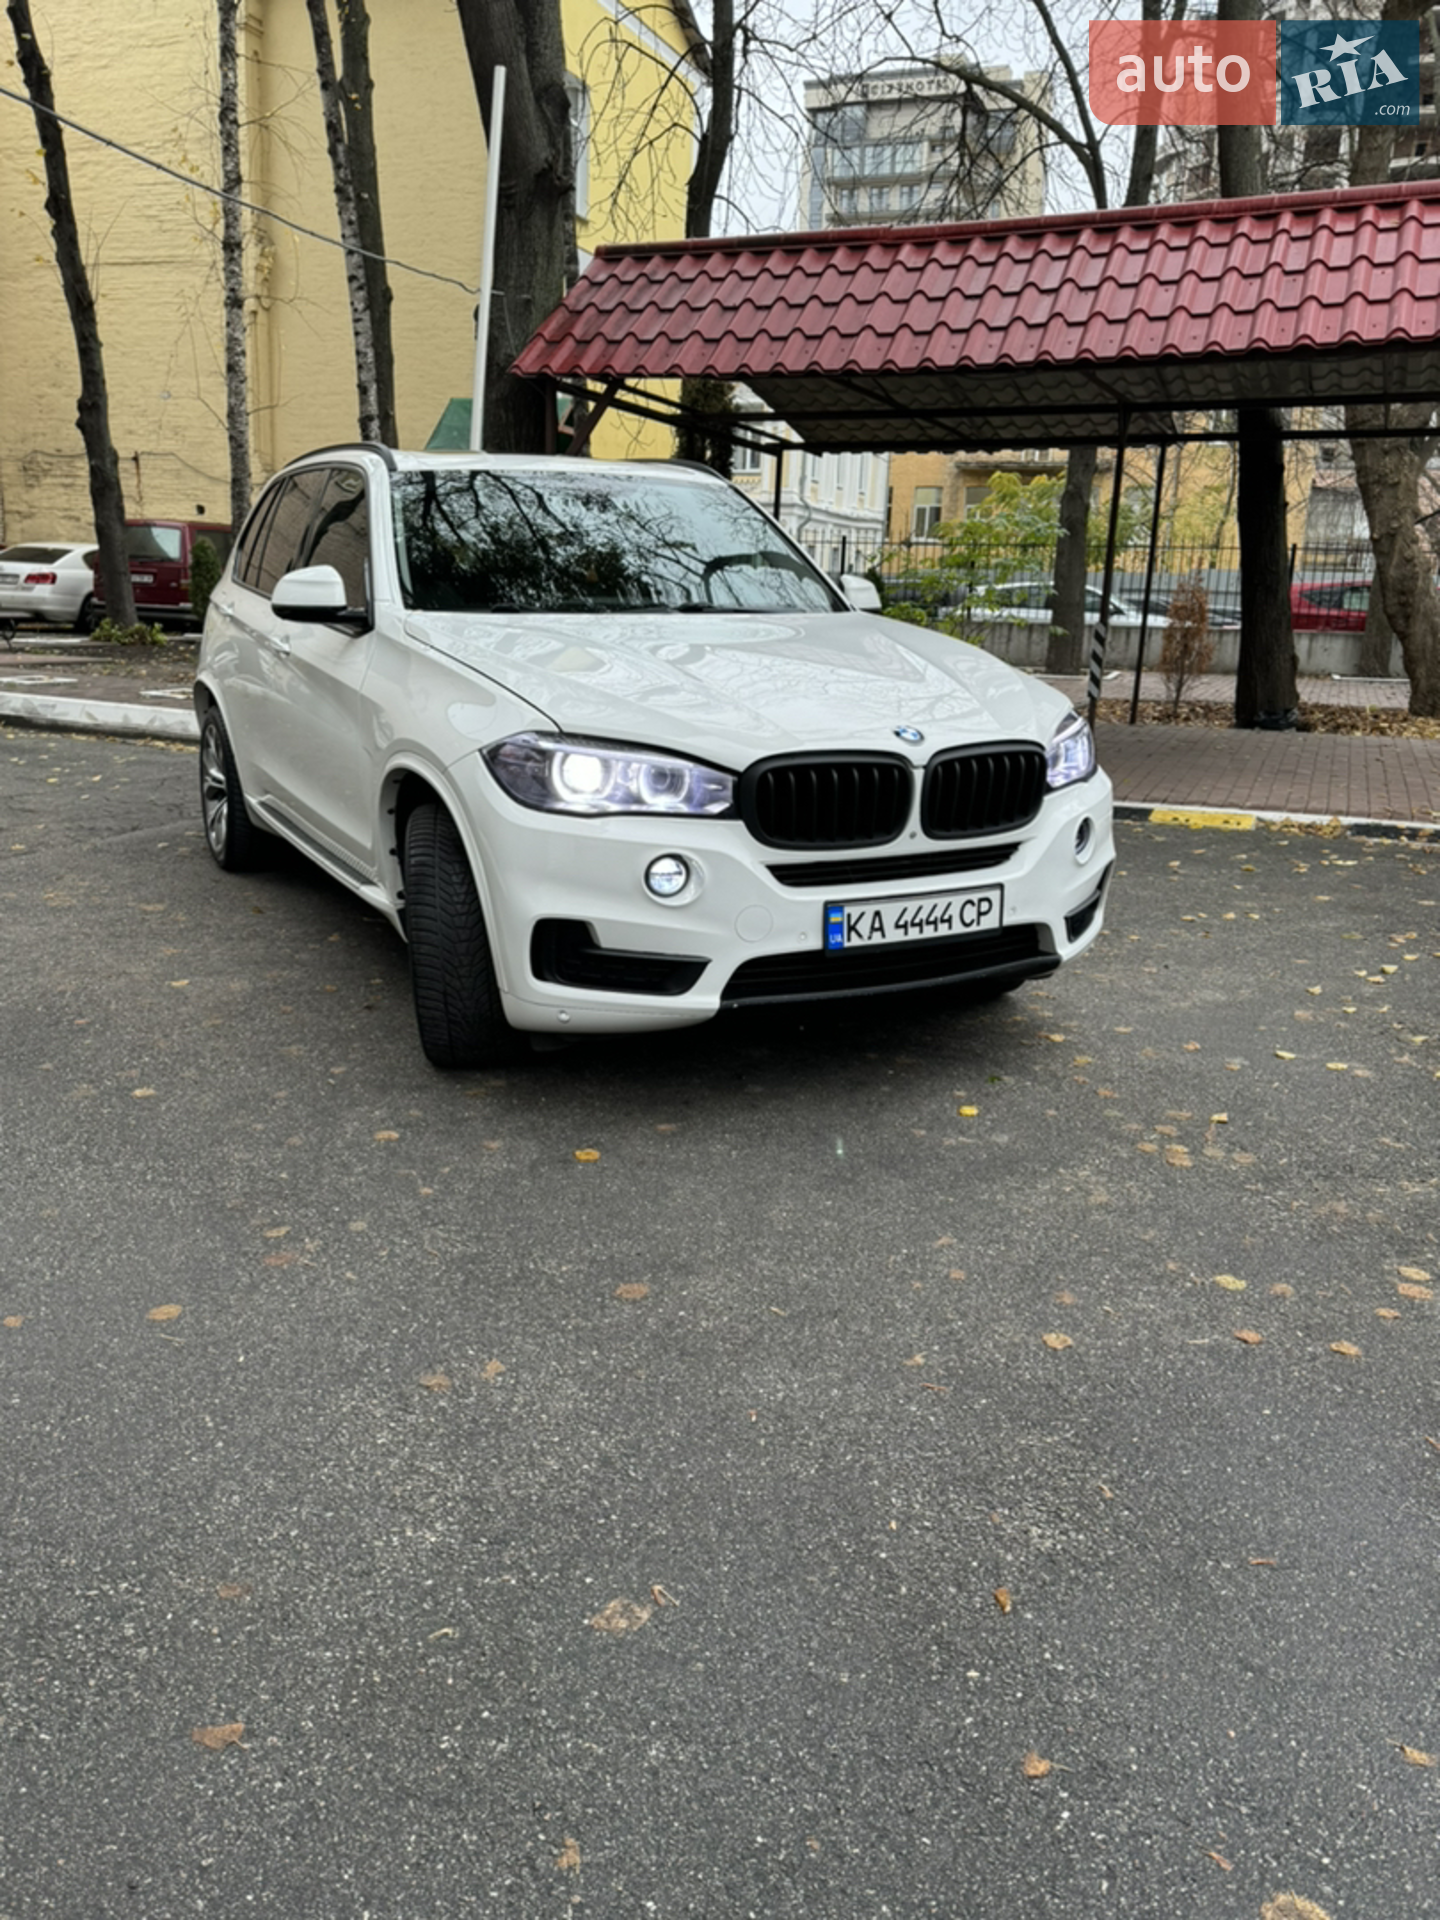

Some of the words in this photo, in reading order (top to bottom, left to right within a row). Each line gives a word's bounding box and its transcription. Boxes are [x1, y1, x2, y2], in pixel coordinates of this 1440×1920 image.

[846, 910, 886, 942] KA
[894, 901, 953, 936] 4444
[959, 897, 993, 928] CP
